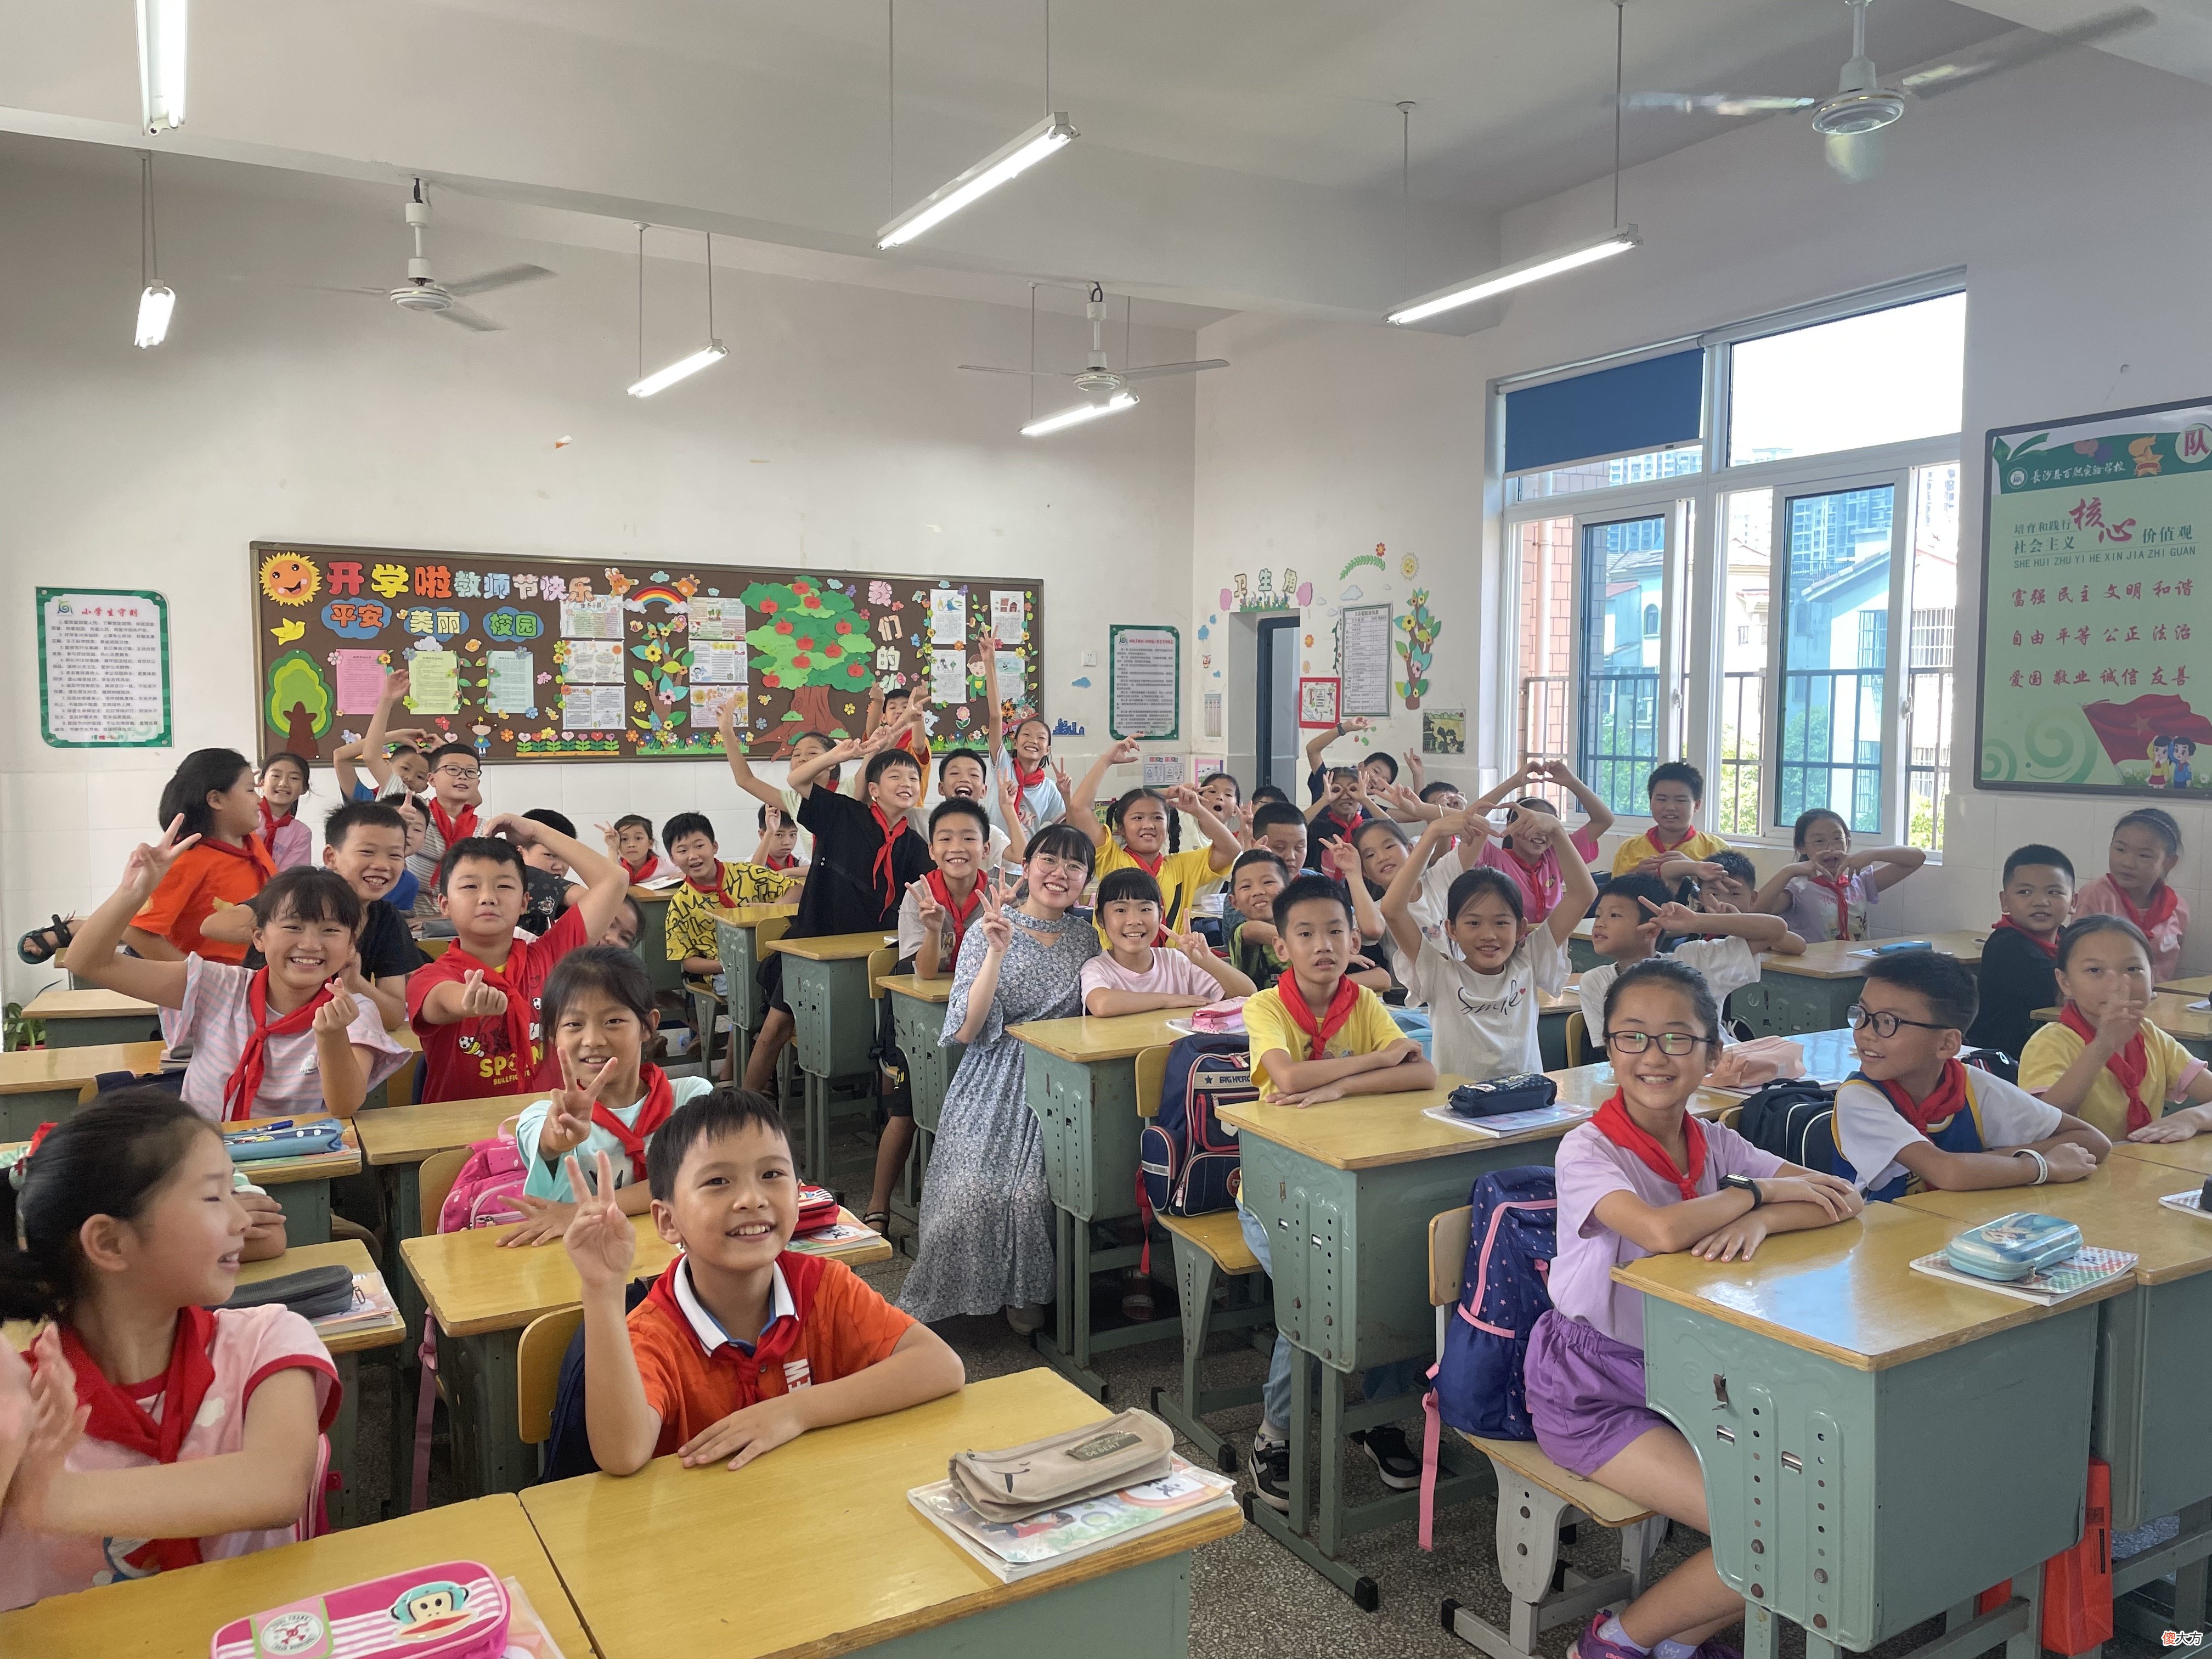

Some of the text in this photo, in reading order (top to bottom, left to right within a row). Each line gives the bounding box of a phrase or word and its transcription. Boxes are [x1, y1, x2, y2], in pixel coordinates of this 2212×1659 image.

[2184, 428, 2210, 456] 队
[2014, 519, 2072, 535] 培育和践行
[2015, 497, 2192, 555] 社会主义 核心 价值观
[2014, 545, 2196, 569] SHE HUI ZHU YI HE XIN JIA ZHI GUAN
[1234, 568, 1297, 597] 卫生角
[2012, 578, 2194, 608] 富强 民主 文明 和谐
[82, 607, 138, 617] 小学生守则
[331, 603, 538, 637] 平安 美丽 校园
[2012, 623, 2191, 647] 自由 平等 公正 法治
[2009, 664, 2190, 688] 爱国 敬业 诚信 友善
